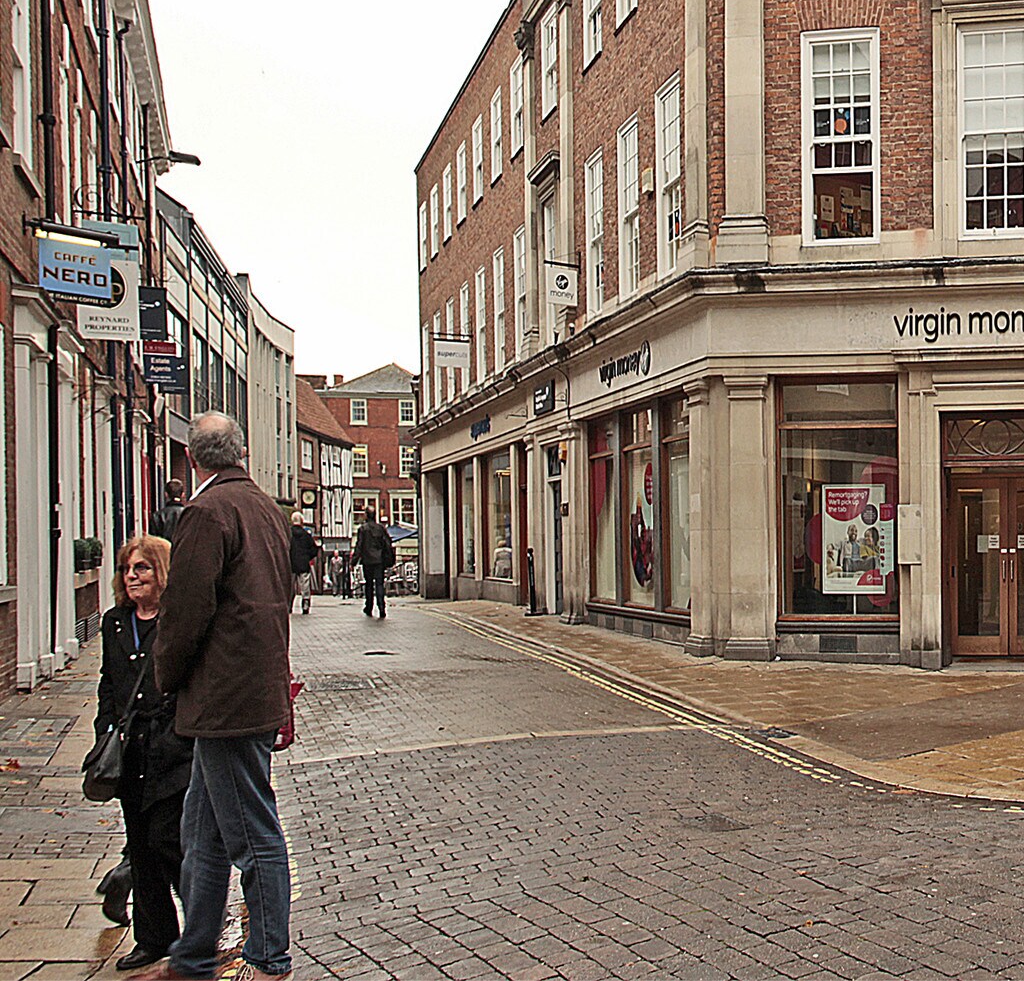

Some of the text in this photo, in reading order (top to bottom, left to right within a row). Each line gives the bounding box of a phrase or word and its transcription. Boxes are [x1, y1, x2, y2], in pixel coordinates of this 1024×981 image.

[43, 265, 107, 287] NERO
[549, 290, 574, 300] money
[89, 315, 130, 323] REYNARD
[84, 323, 135, 332] PROPERTIES
[893, 307, 961, 343] virgin
[150, 365, 172, 373] Agents
[828, 491, 868, 500] Remortgaging?
